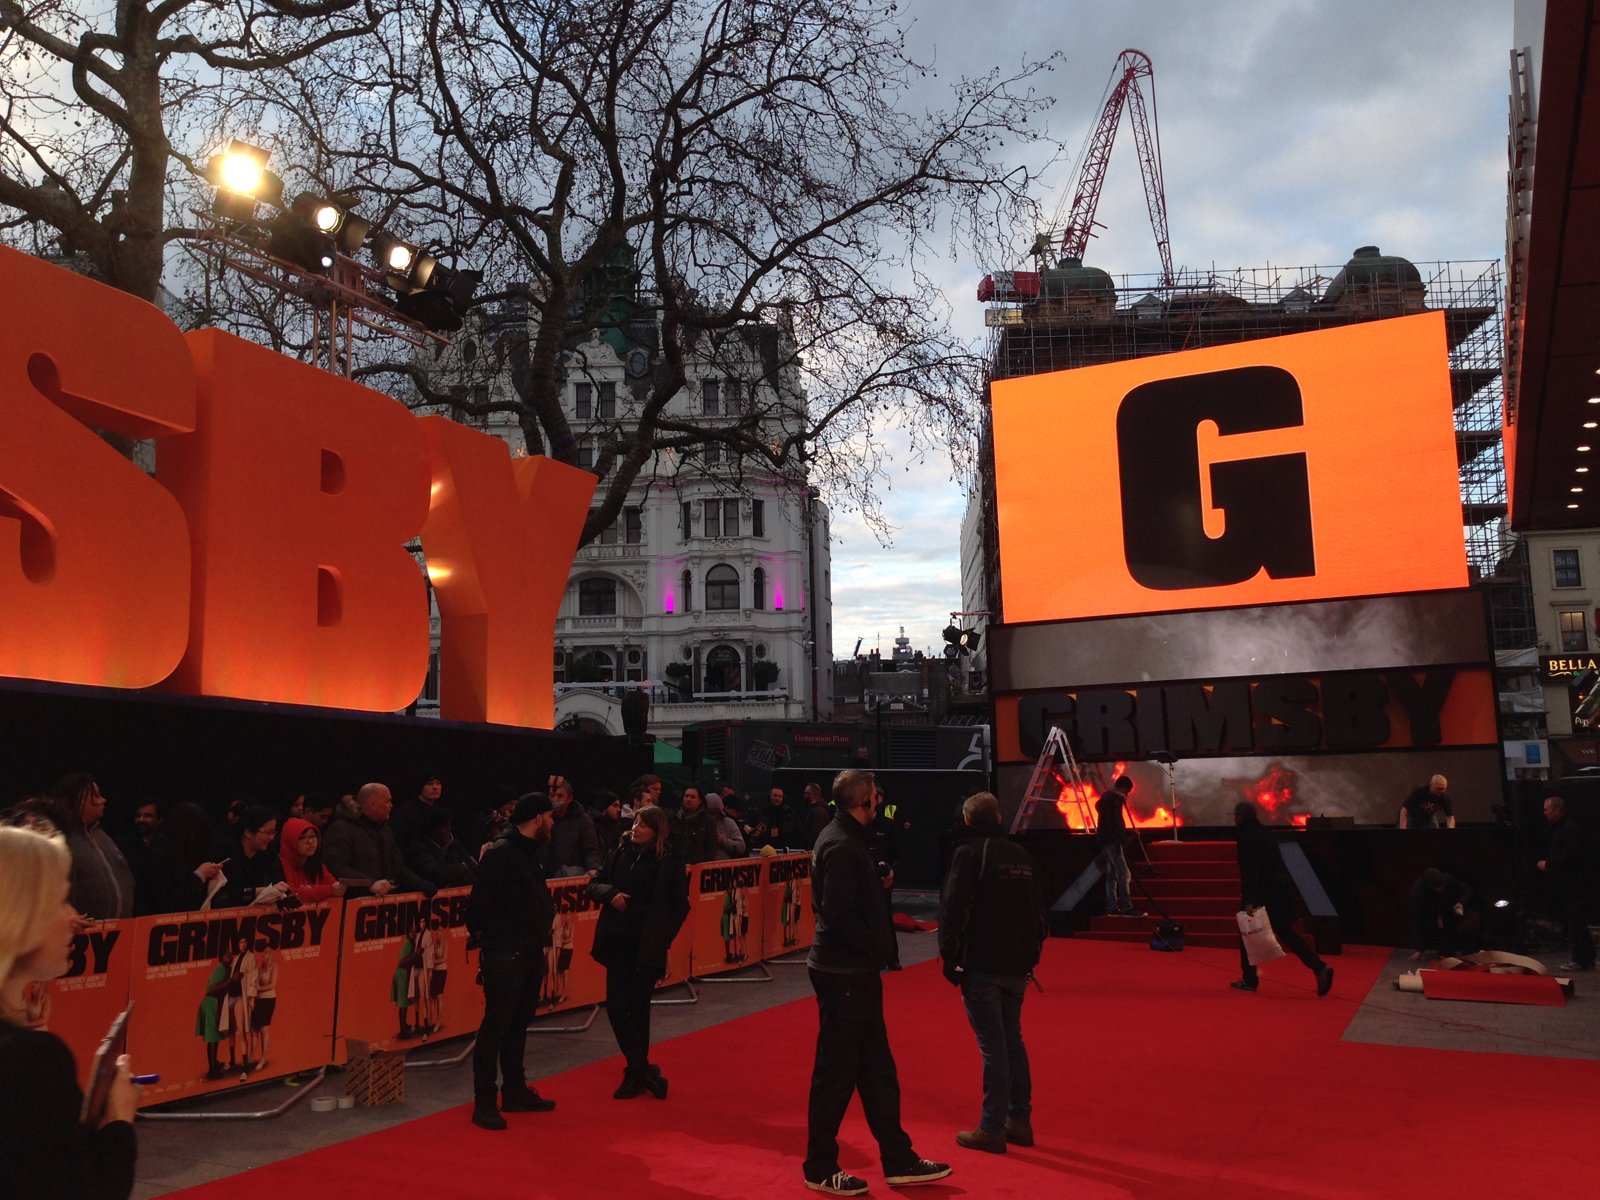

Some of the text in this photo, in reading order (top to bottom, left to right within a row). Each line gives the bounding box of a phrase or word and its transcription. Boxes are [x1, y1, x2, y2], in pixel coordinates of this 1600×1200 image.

[1116, 365, 1317, 591] G
[1549, 658, 1598, 671] BELLA
[1018, 669, 1455, 758] GRIMSBY
[700, 863, 762, 894] GRIMSBY
[769, 858, 812, 884] GRIMSB
[147, 908, 331, 967] GRIMSBY
[355, 896, 470, 942] GRIMSB
